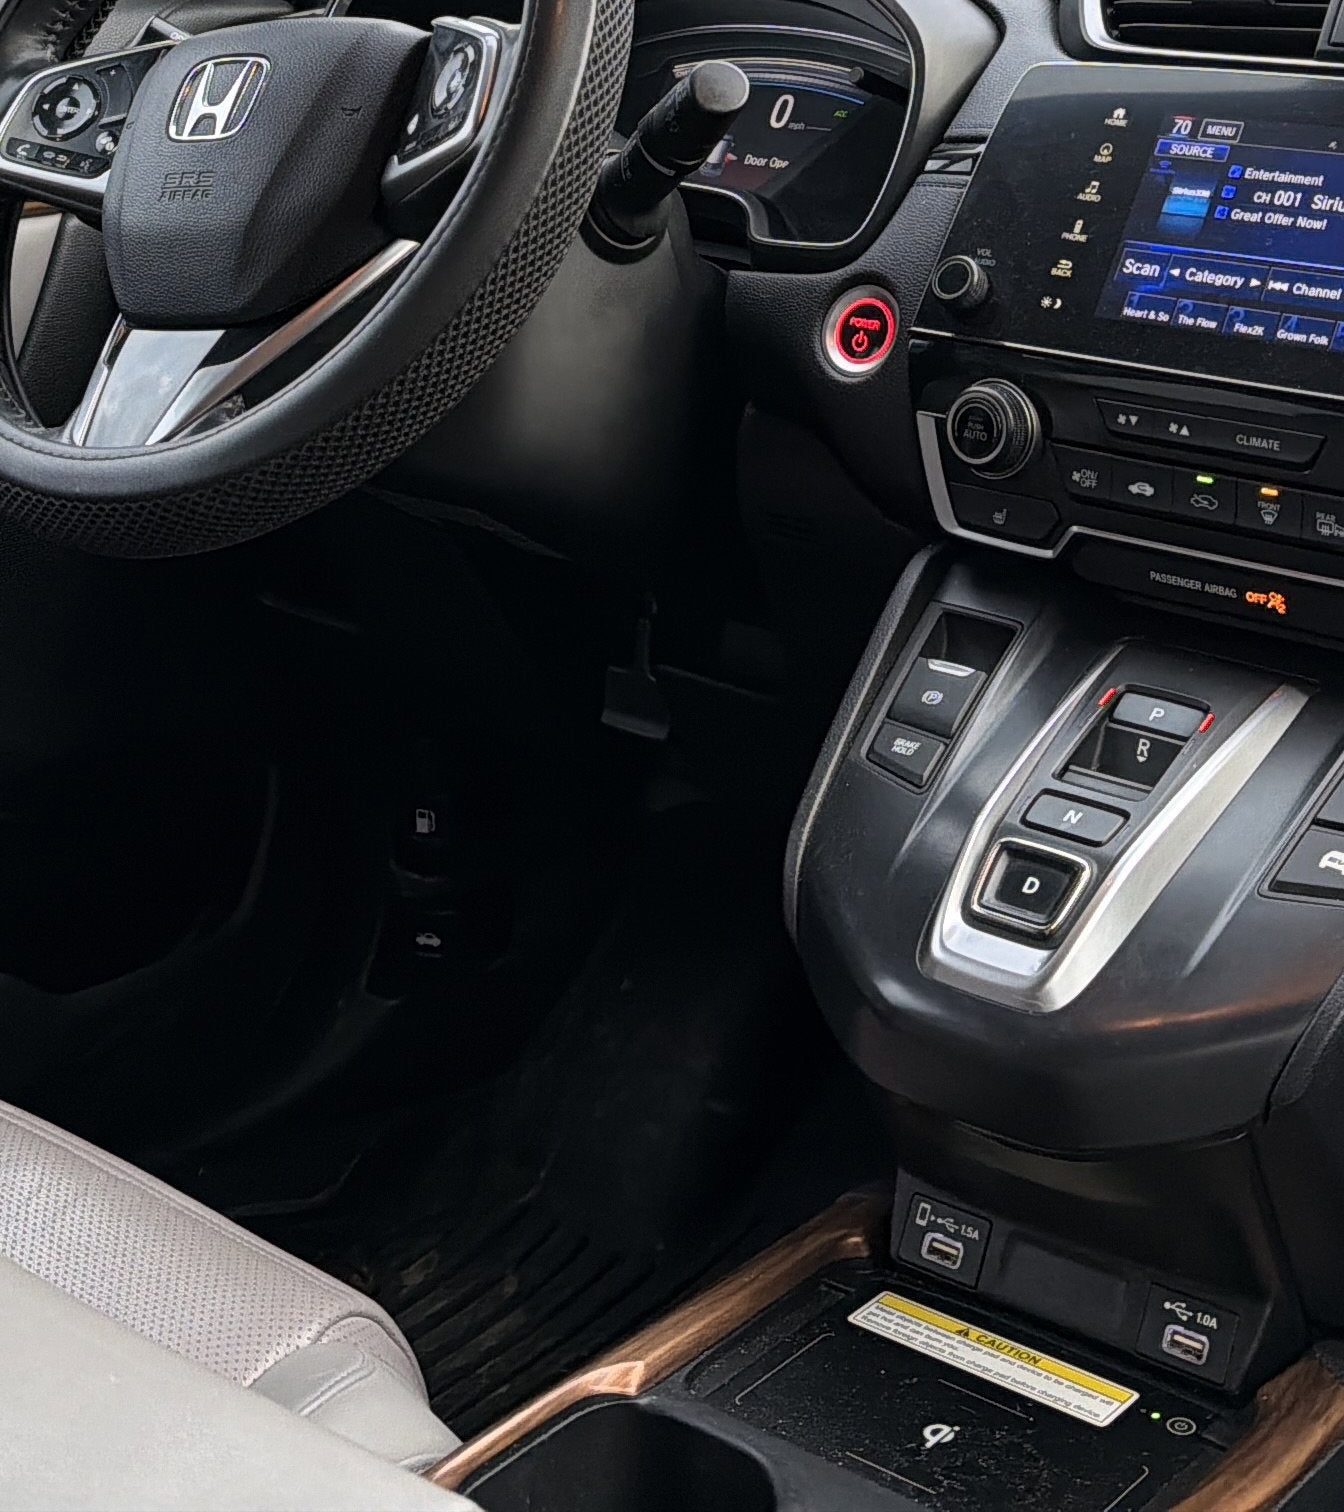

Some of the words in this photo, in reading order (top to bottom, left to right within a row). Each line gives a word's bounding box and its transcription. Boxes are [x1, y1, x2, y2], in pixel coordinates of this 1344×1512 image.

[769, 94, 795, 129] 0
[1104, 118, 1129, 127] HOME
[1172, 120, 1192, 134] 70
[1206, 124, 1236, 137] MENU
[1169, 144, 1215, 158] SOURCE
[744, 154, 768, 167] Door
[1093, 155, 1112, 163] MAP
[164, 171, 217, 187] SRS
[1244, 168, 1325, 187] Entertainment
[159, 189, 216, 202] AIRBAG
[1076, 193, 1102, 203] AUDIO
[1253, 191, 1271, 203] CH
[1273, 190, 1302, 207] 001
[1231, 208, 1262, 222] Great
[1264, 212, 1294, 227] Offer
[1296, 216, 1328, 231] Now!
[1061, 232, 1089, 243] PHONE
[977, 247, 992, 257] VOL
[1051, 268, 1073, 278] BACK
[1122, 258, 1161, 278] Scan
[1185, 267, 1246, 289] Category
[1292, 282, 1342, 301] Channel
[1122, 306, 1148, 319] Heart
[1148, 311, 1157, 320] &
[1157, 311, 1170, 322] So
[849, 317, 881, 331] POWER
[1178, 315, 1195, 326] The
[1196, 317, 1218, 329] Flow
[1233, 323, 1265, 336] Flex2K
[1277, 329, 1307, 343] Grown
[1308, 333, 1329, 346] Folk
[963, 430, 988, 442] AUTO
[1235, 434, 1281, 452] CLIMATE
[1080, 469, 1099, 480] ON/
[1080, 479, 1098, 489] OFF
[1257, 501, 1281, 511] FRONT
[1316, 511, 1336, 522] REAR
[1149, 571, 1202, 591] PASSENGER
[1204, 583, 1237, 598] AIRBAG
[1245, 591, 1267, 604] OFF
[1148, 707, 1165, 722] P
[1136, 739, 1151, 757] R
[1063, 809, 1084, 824] N
[1021, 876, 1041, 894] D
[960, 1223, 980, 1241] 1.5A
[1196, 1311, 1218, 1329] 1.0A
[975, 1334, 1042, 1365] CAUTION
